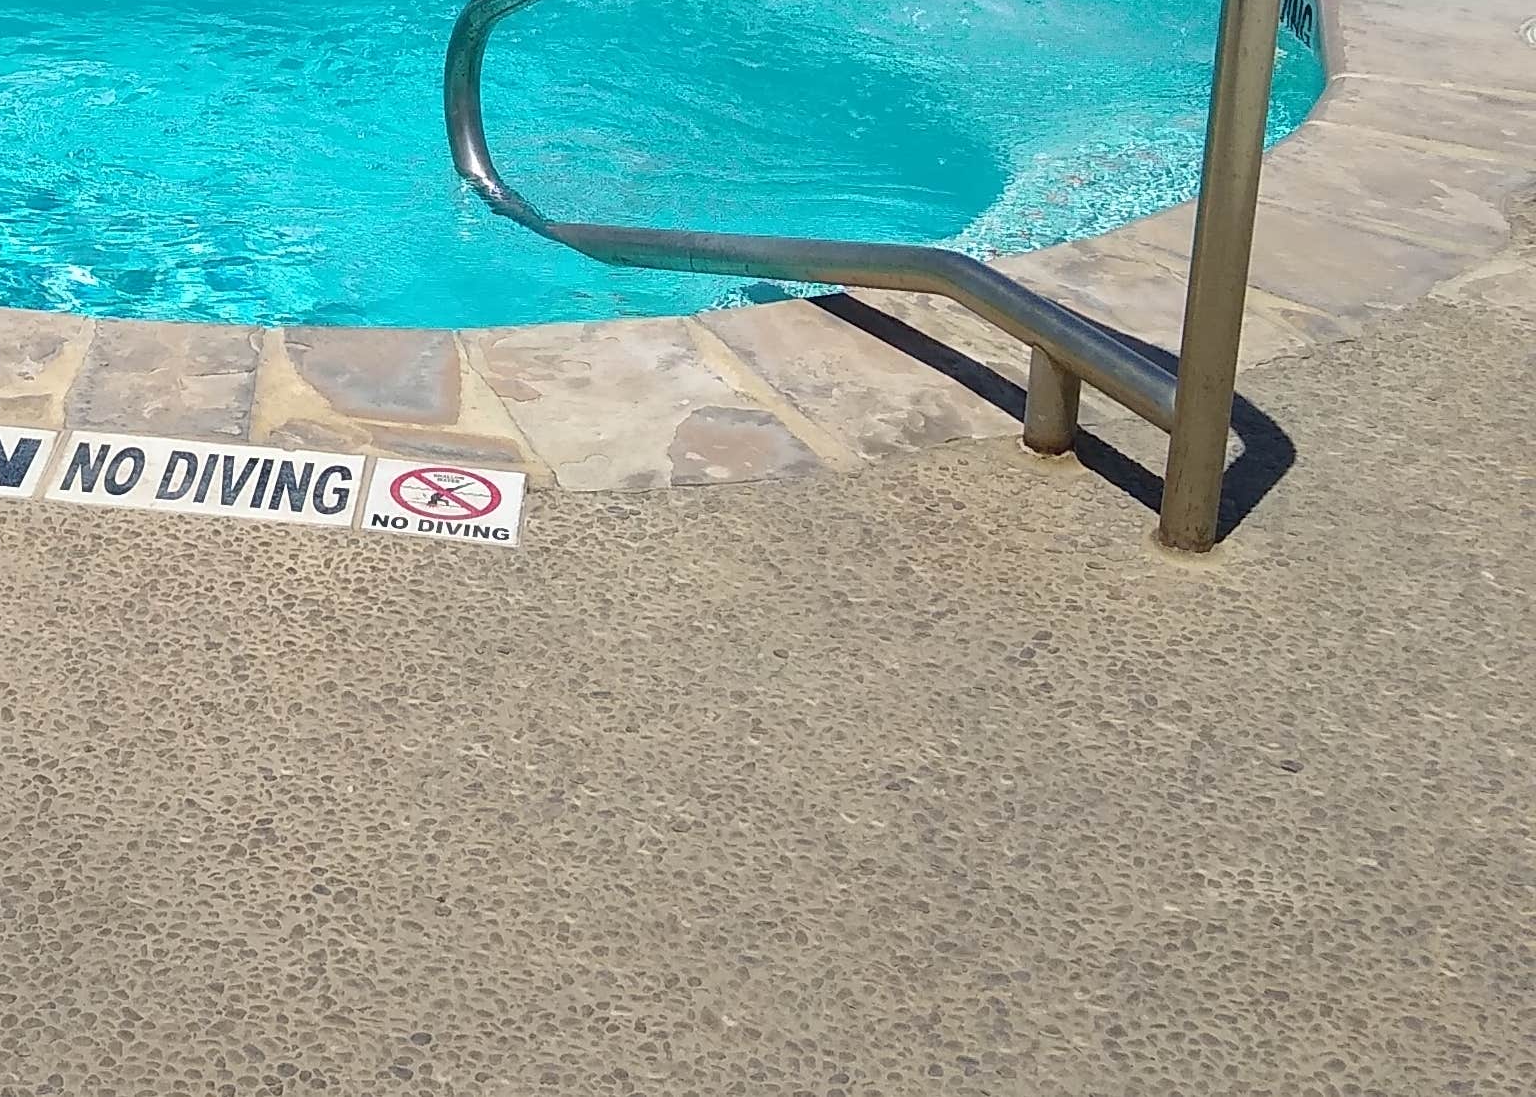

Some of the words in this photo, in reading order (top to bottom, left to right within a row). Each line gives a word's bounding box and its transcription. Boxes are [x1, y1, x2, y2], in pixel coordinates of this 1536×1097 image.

[59, 441, 146, 496] NO
[155, 450, 353, 515] DIVING
[371, 513, 409, 530] NO
[417, 519, 511, 541] DIVING
